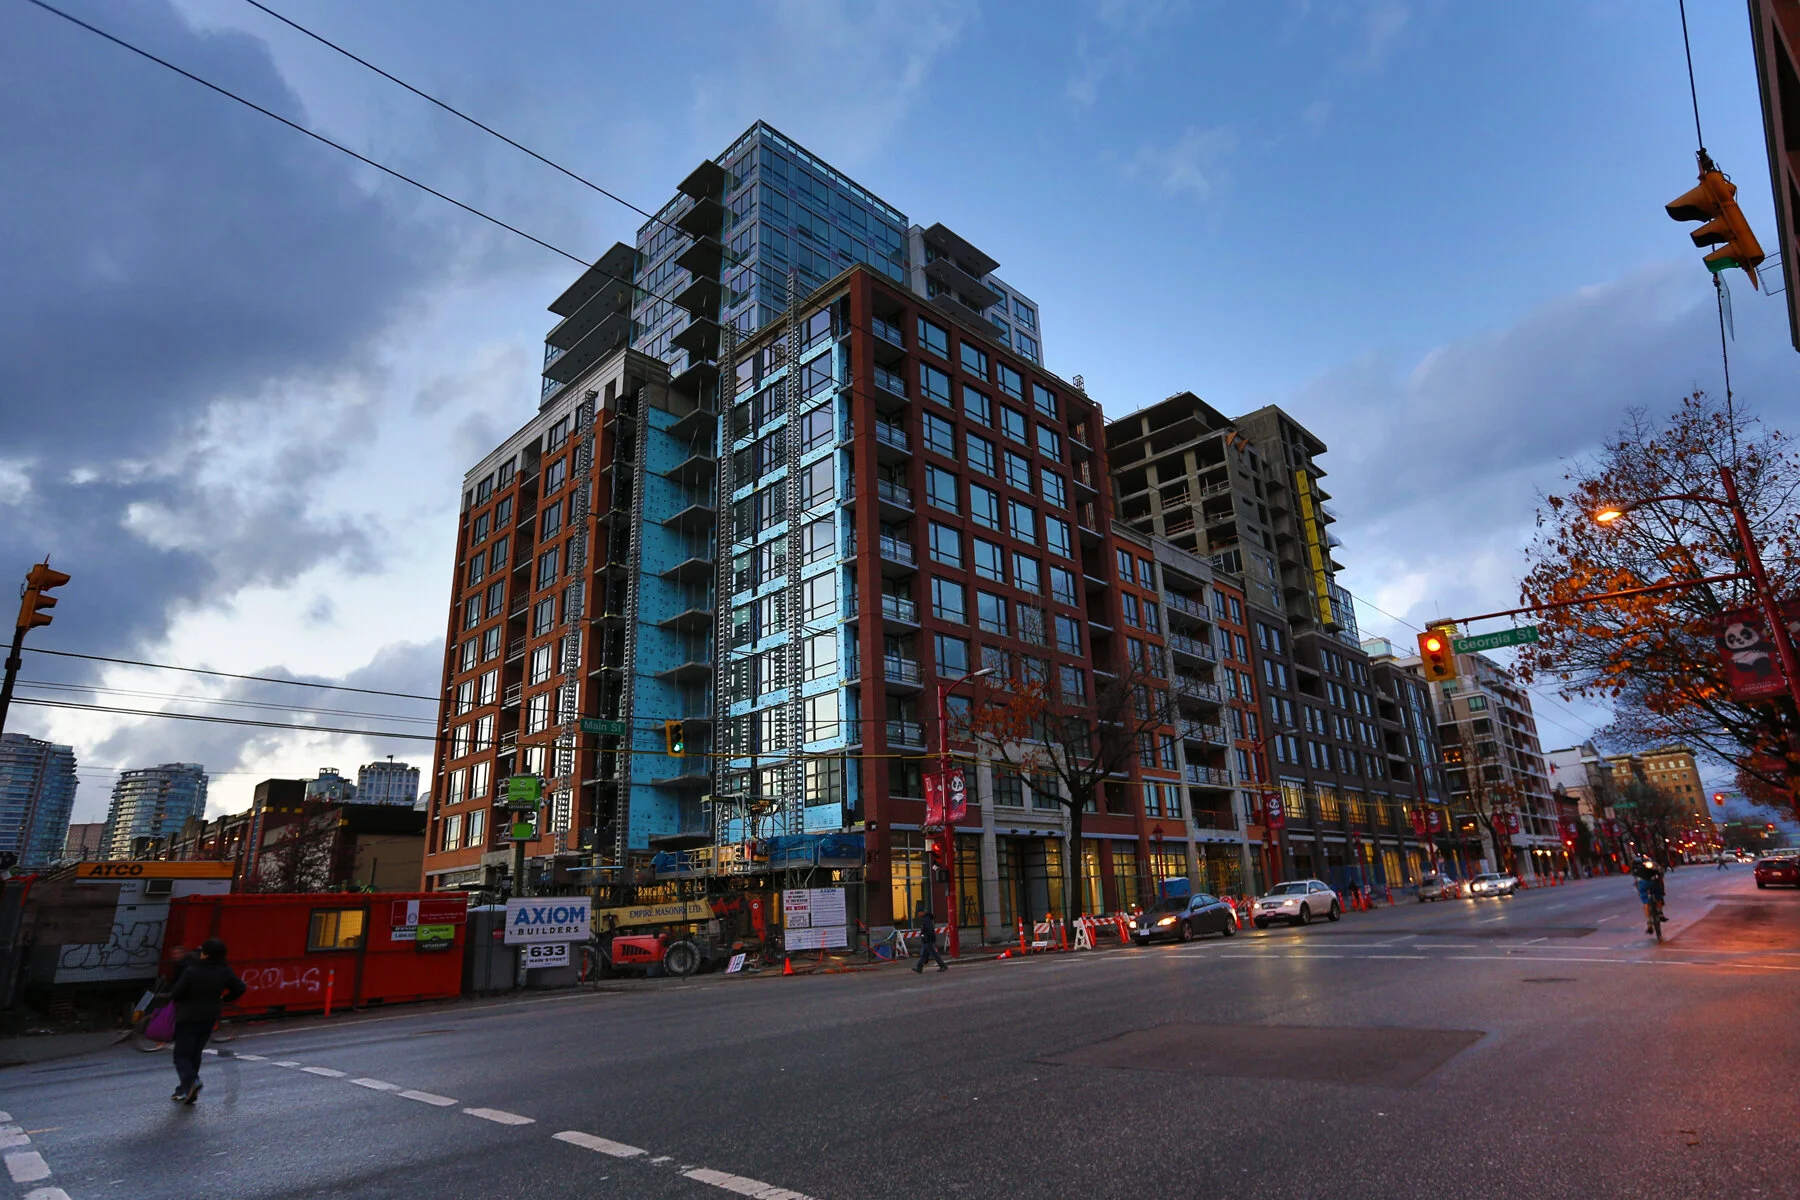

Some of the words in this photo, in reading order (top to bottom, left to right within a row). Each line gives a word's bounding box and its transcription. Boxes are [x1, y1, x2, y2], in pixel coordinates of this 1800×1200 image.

[1458, 633, 1511, 651] Georgia
[1516, 628, 1533, 640] St
[584, 720, 607, 731] Main
[611, 722, 622, 732] St
[89, 864, 143, 876] ATCO
[513, 906, 585, 926] AXIOM
[629, 910, 653, 919] EMPIRE
[518, 926, 580, 936] BUILDERS
[530, 945, 566, 957] 633
